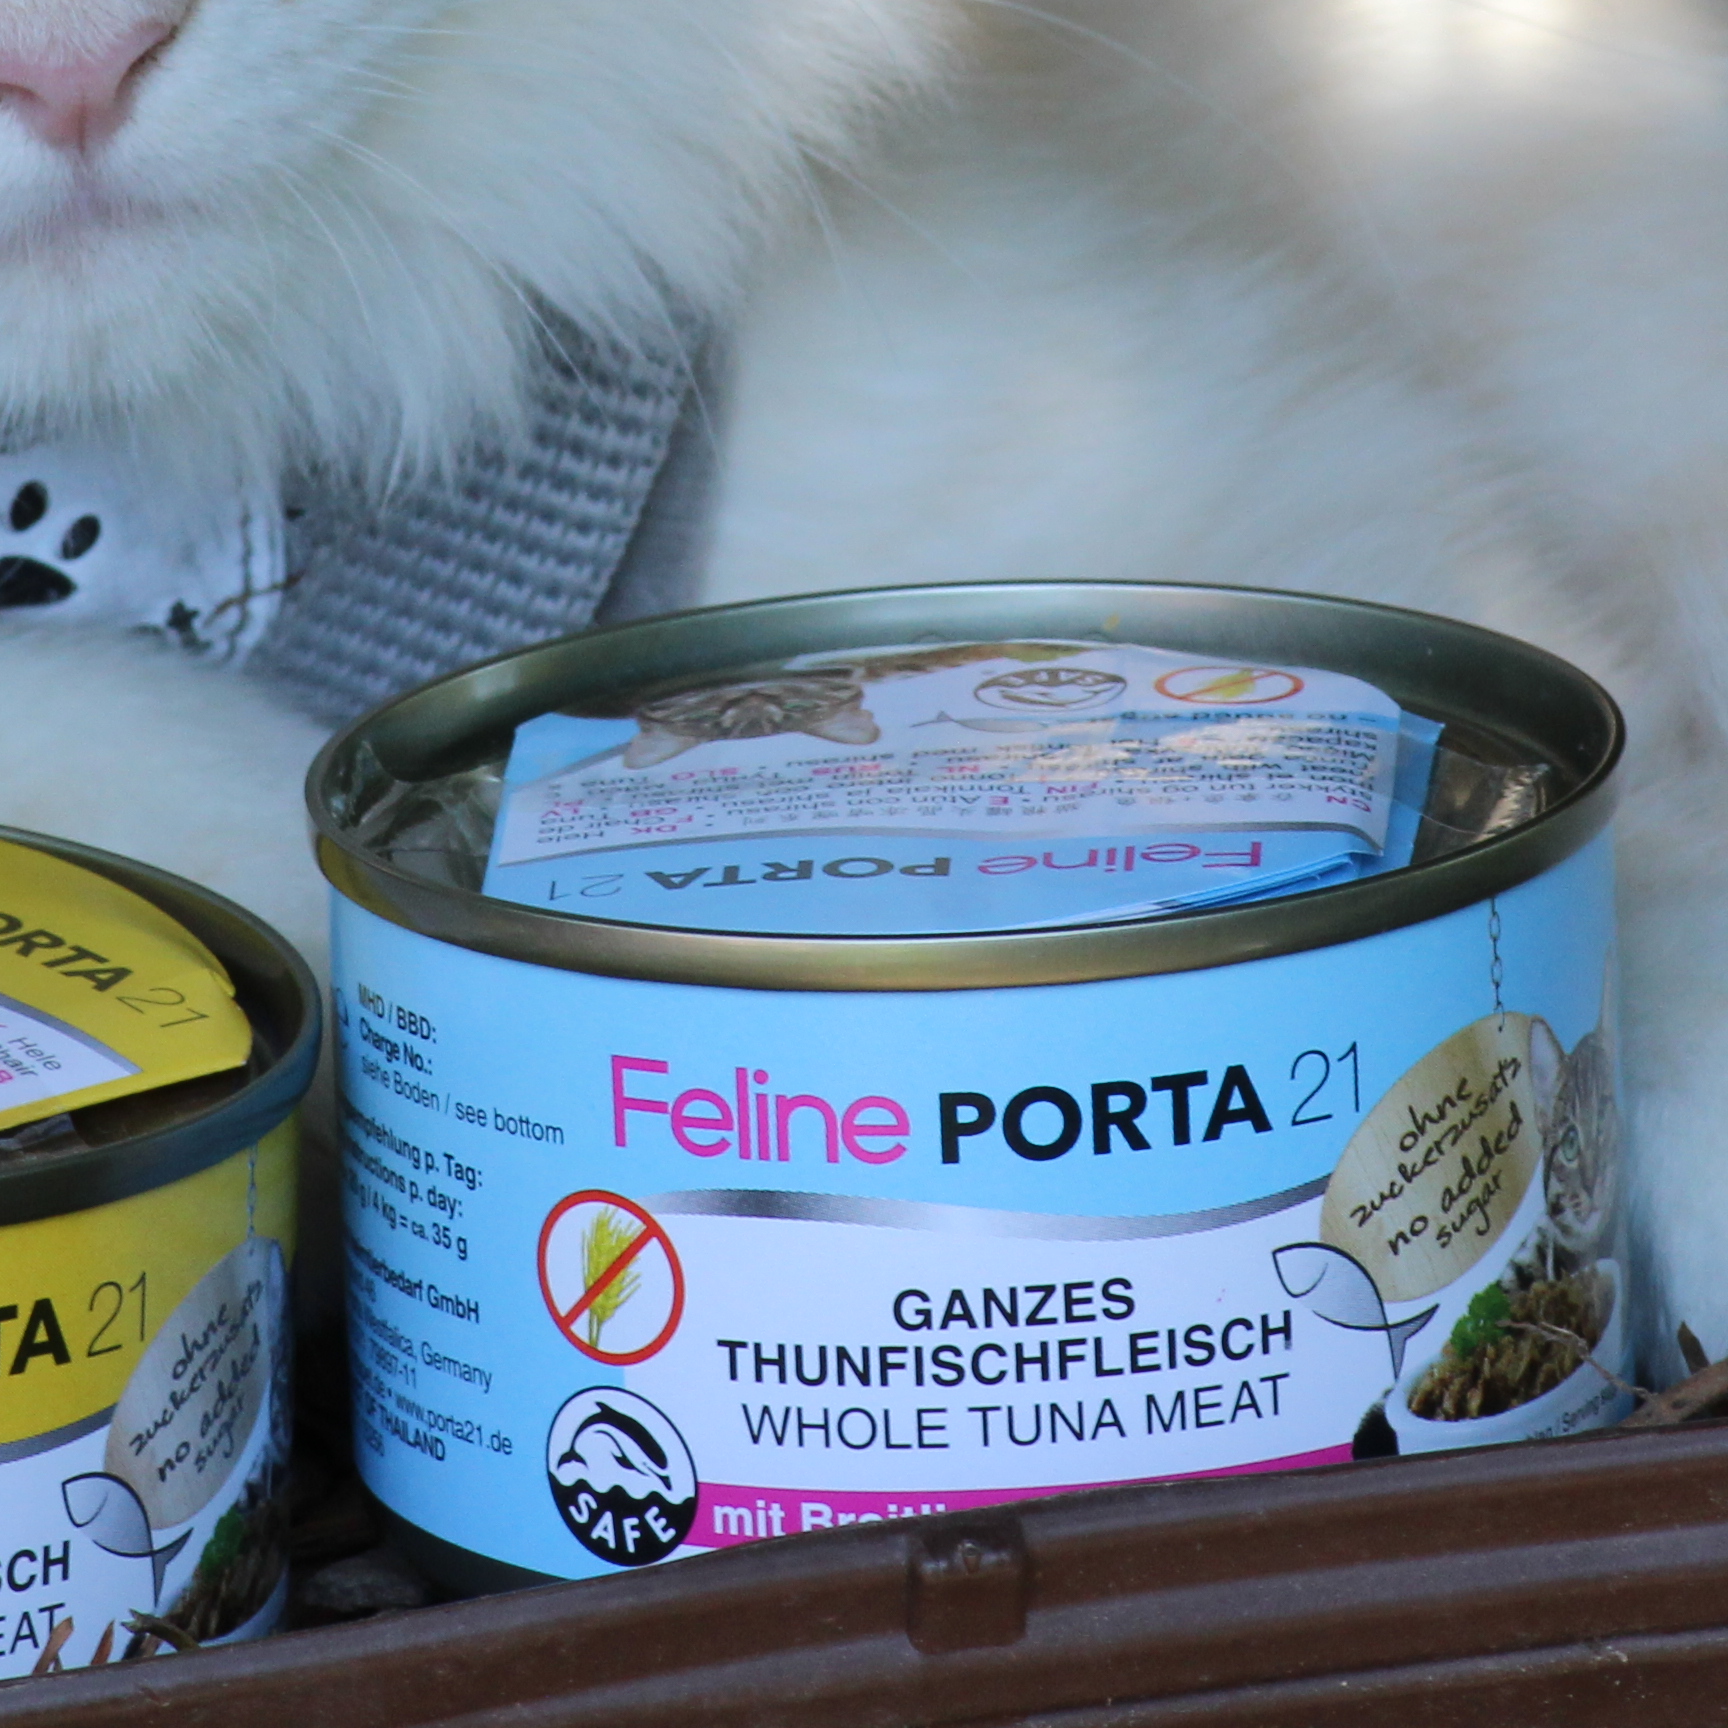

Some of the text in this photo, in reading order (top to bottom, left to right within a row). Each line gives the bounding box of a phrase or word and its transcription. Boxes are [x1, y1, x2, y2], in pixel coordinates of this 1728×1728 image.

[632, 825, 677, 834] DK
[548, 841, 1262, 901] Feline PORTA 21
[117, 987, 210, 1029] 21
[358, 982, 384, 1019] MHD
[396, 1005, 437, 1044] BBD:
[8, 1035, 63, 1073] Hele
[359, 1016, 400, 1063] Charge
[394, 1070, 440, 1112] Boden
[455, 1101, 488, 1128] see
[493, 1107, 565, 1149] bottom
[610, 1041, 1361, 1164] Feline PORTA 21
[1399, 1076, 1473, 1153] ohne
[409, 1179, 463, 1221] p. day:
[424, 1150, 483, 1191] p. Tag:
[1387, 1100, 1524, 1257] no added
[1435, 1169, 1502, 1249] sugar
[411, 1221, 430, 1242] ca.
[432, 1222, 452, 1250] 35
[456, 1236, 468, 1261] g
[85, 1270, 148, 1359] 21
[426, 1284, 480, 1325] GmbH
[892, 1278, 1136, 1332] GANZES
[172, 1302, 229, 1381] ohne
[421, 1341, 493, 1394] Germany
[717, 1310, 1293, 1388] THUNFISCHFLEISCH
[156, 1322, 261, 1484] no added
[396, 1392, 514, 1456] www.porta21.de
[742, 1373, 1292, 1450] WHOLE TUNA MEAT
[568, 1493, 676, 1553] SAFE
[712, 1499, 786, 1538] mit
